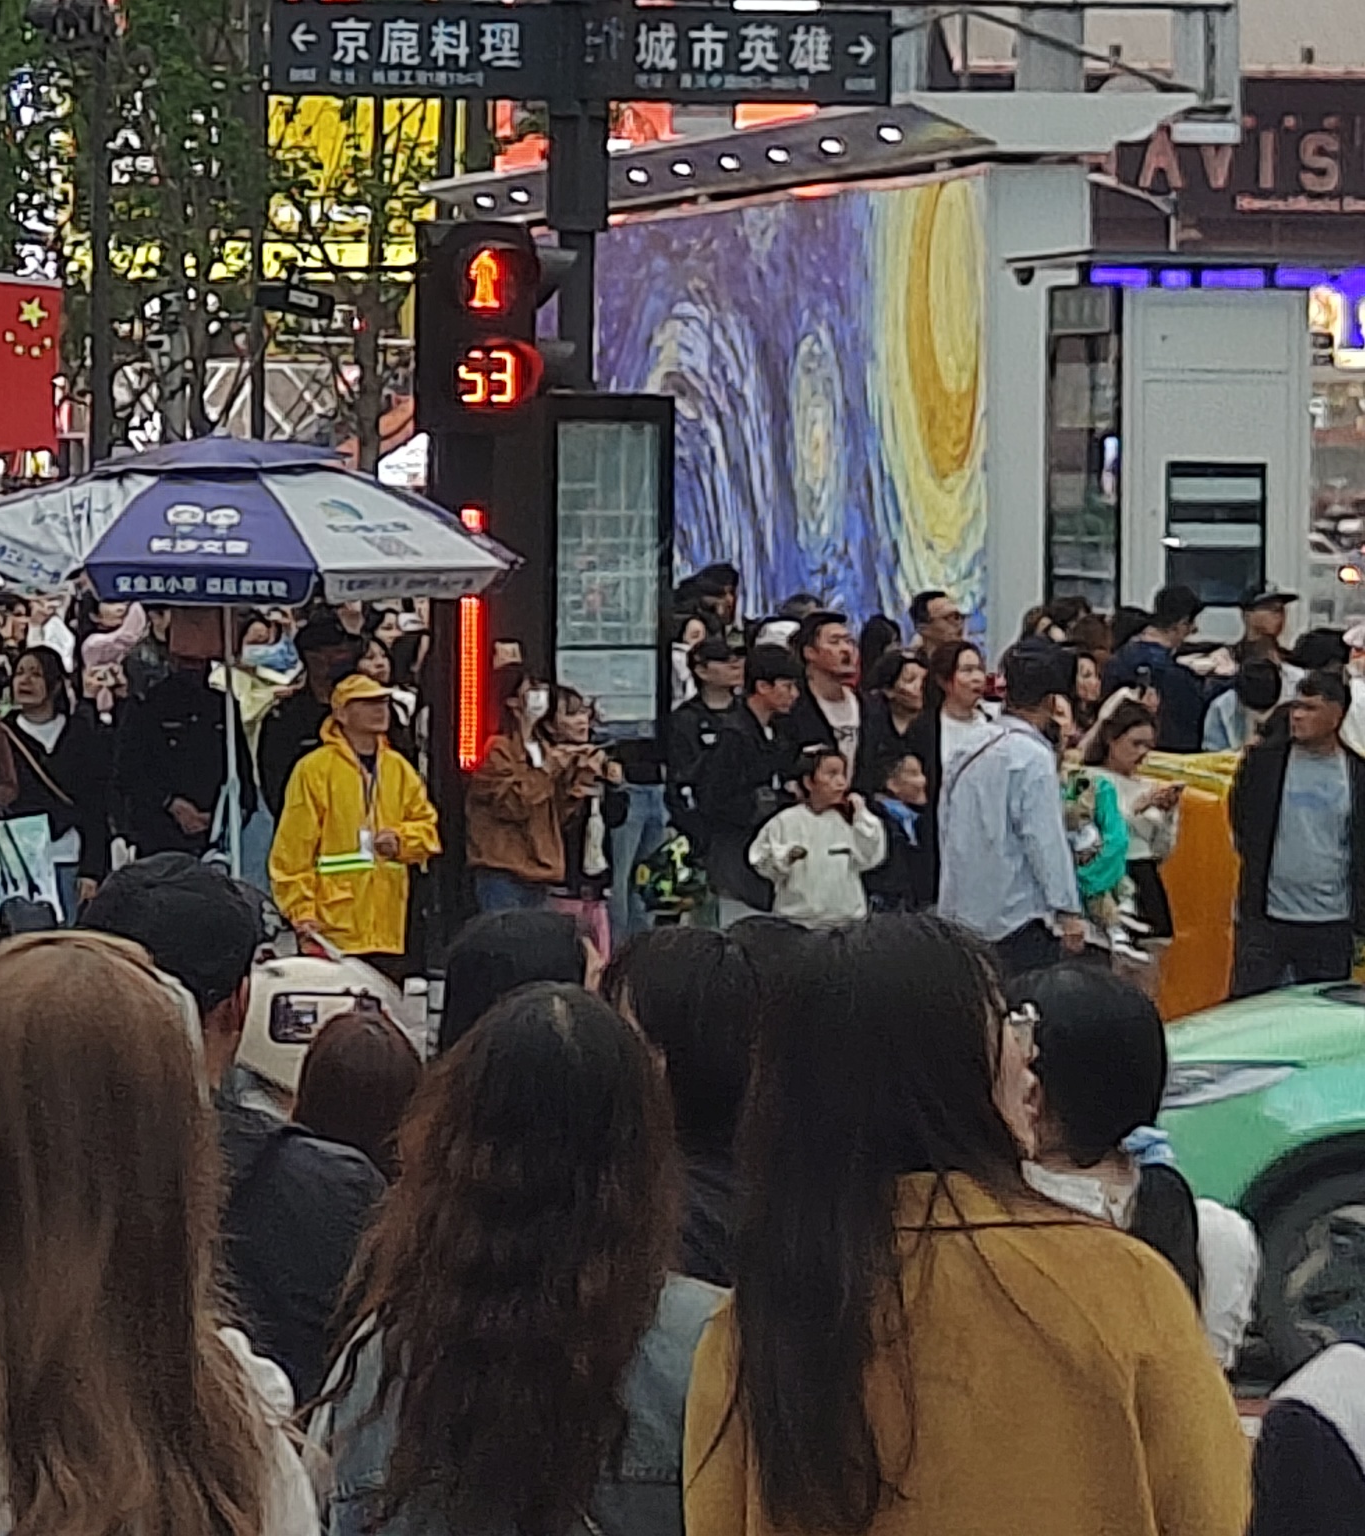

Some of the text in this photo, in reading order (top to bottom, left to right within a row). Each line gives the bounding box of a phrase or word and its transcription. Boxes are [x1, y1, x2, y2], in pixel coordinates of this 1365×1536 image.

[330, 16, 523, 70] 京鹿料理
[635, 20, 832, 74] 城市英雄
[456, 349, 518, 405] 53
